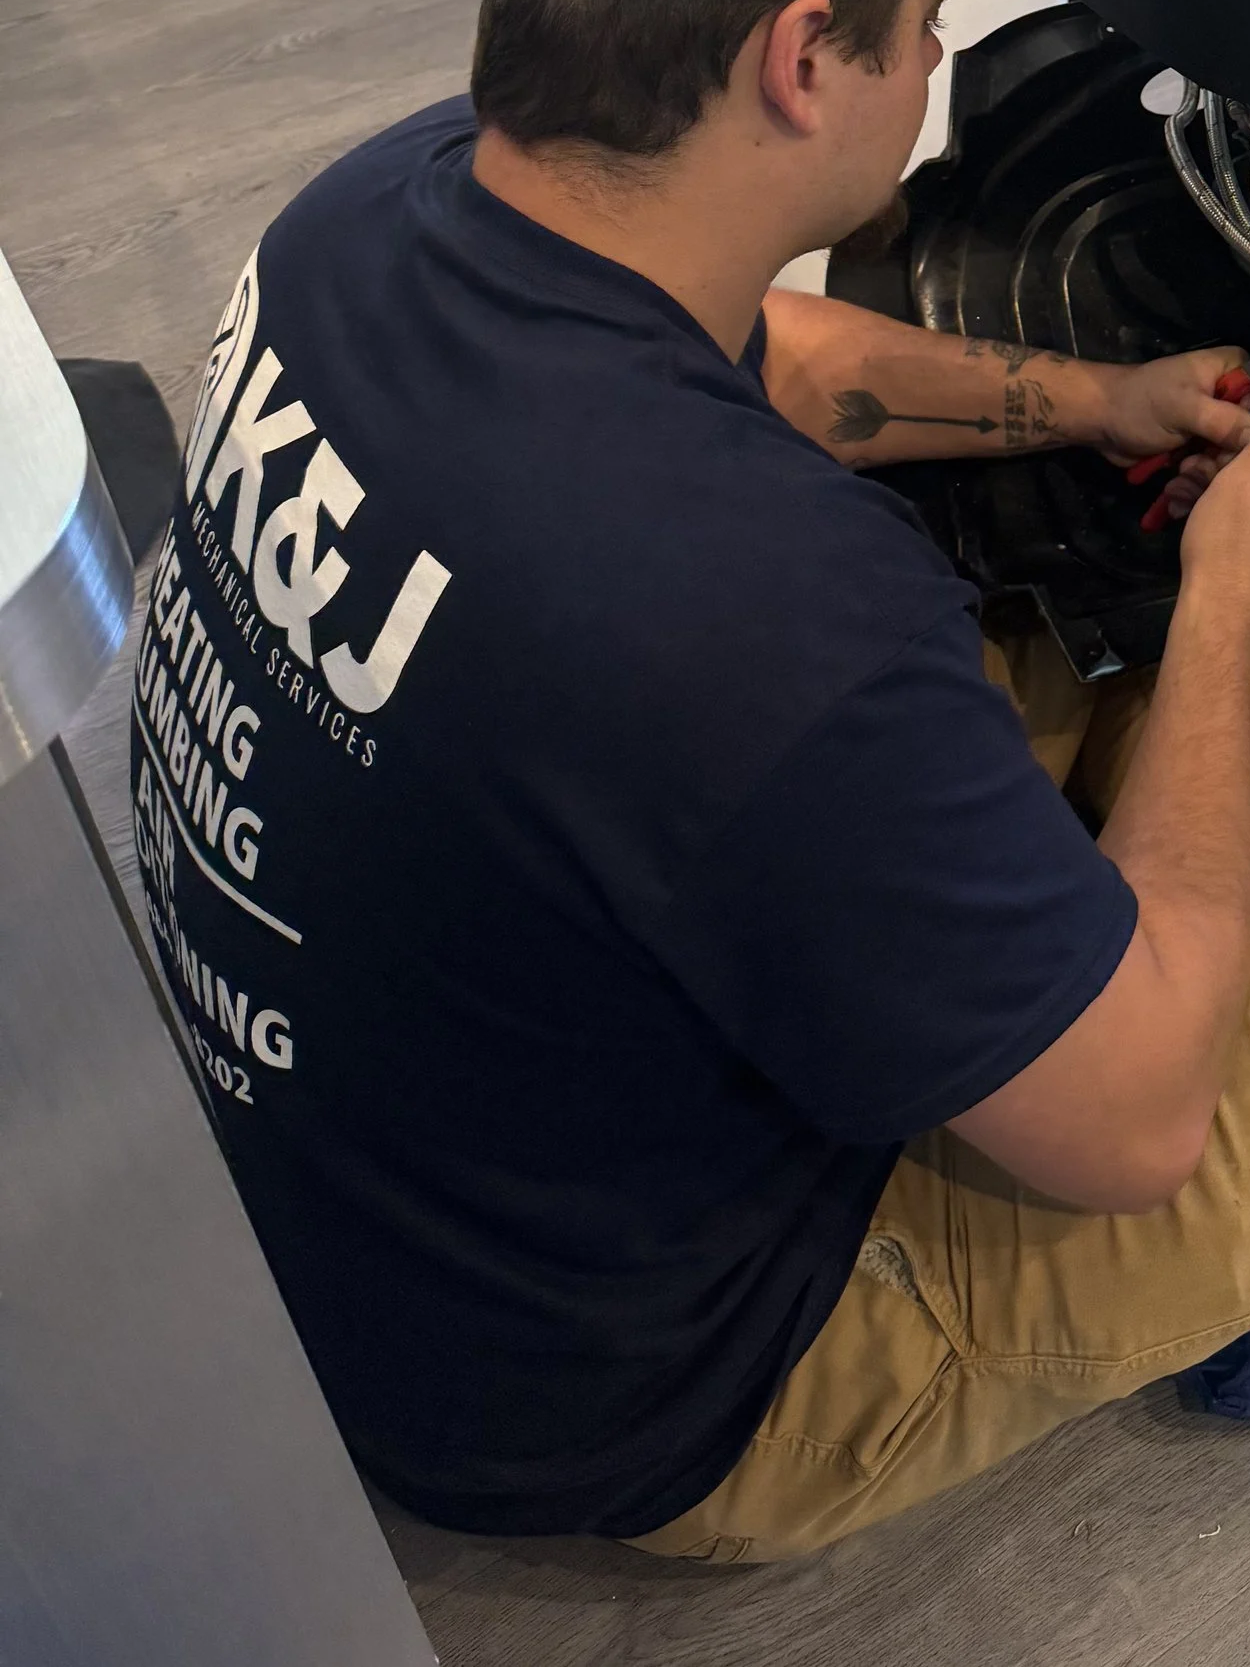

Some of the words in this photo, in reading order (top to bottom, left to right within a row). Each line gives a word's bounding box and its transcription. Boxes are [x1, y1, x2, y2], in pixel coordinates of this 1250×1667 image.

[151, 517, 261, 781] HEATING
[192, 501, 257, 654] MECHANICAL
[266, 647, 377, 768] SERVICES
[205, 347, 452, 714] K&J
[137, 619, 263, 881] UMBING
